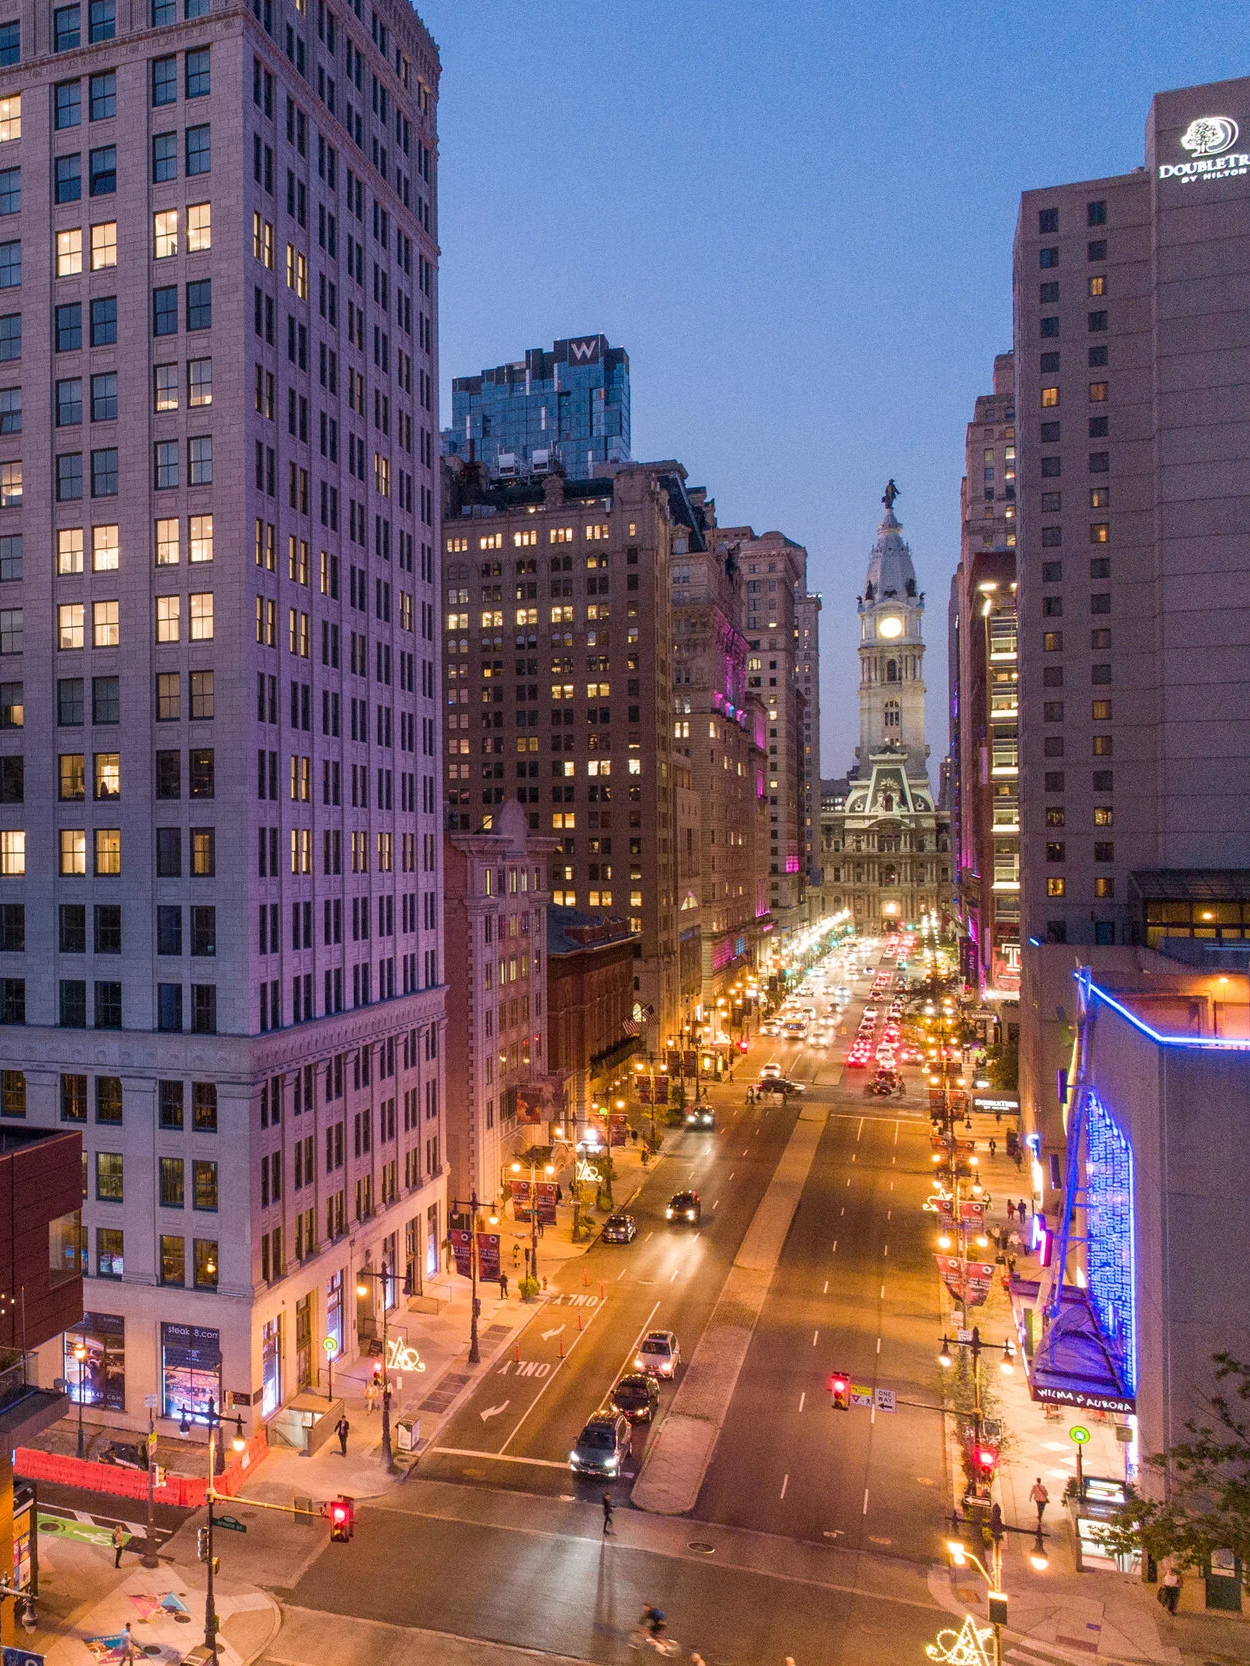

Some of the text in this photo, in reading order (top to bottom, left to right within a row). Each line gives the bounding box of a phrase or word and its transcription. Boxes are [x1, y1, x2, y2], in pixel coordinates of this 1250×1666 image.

[1203, 167, 1248, 180] HILTON
[571, 340, 596, 360] W
[553, 1294, 598, 1307] ONLY
[168, 1325, 219, 1340] steak8.com
[497, 1360, 551, 1378] ONLY
[1037, 1389, 1133, 1411] WILMA AURORA
